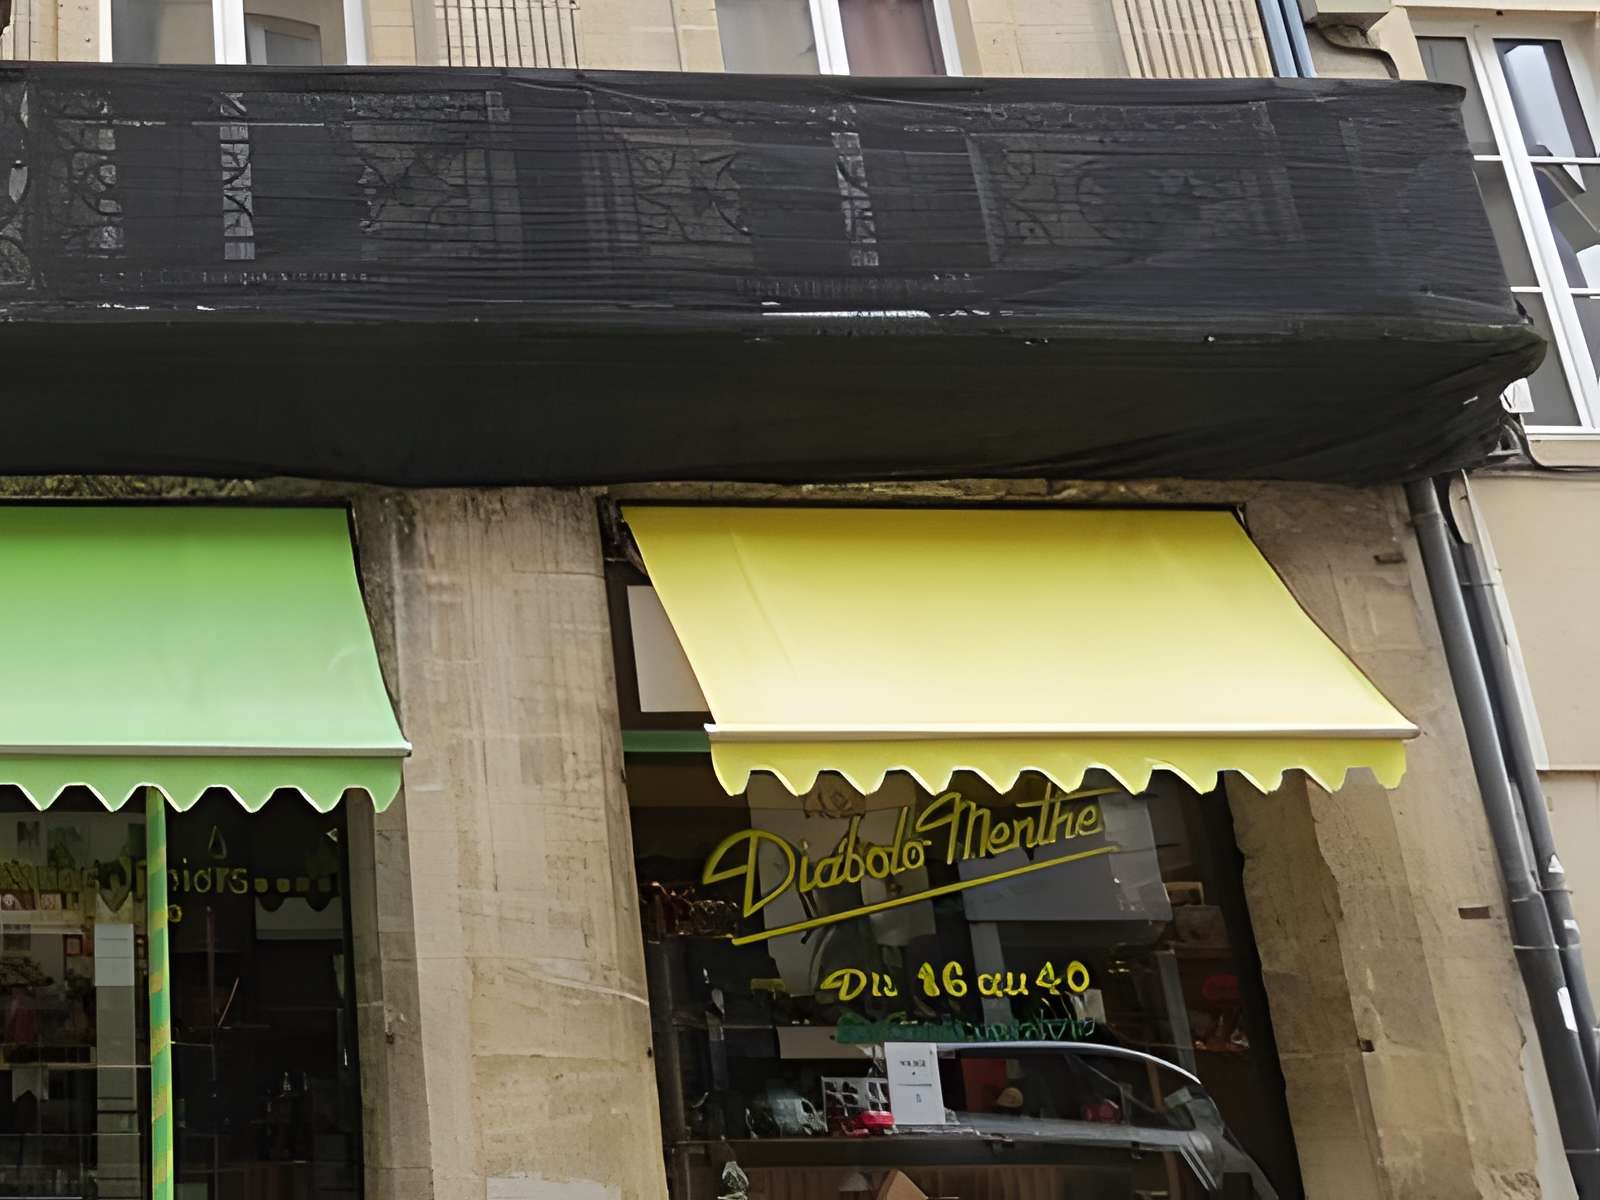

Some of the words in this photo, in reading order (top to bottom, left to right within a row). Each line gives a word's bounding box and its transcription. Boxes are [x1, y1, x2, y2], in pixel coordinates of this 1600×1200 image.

[701, 806, 931, 918] Diabolo
[915, 783, 1116, 865] Menthe
[917, 960, 968, 998] 16
[977, 970, 1029, 998] au
[1035, 960, 1090, 996] 40
